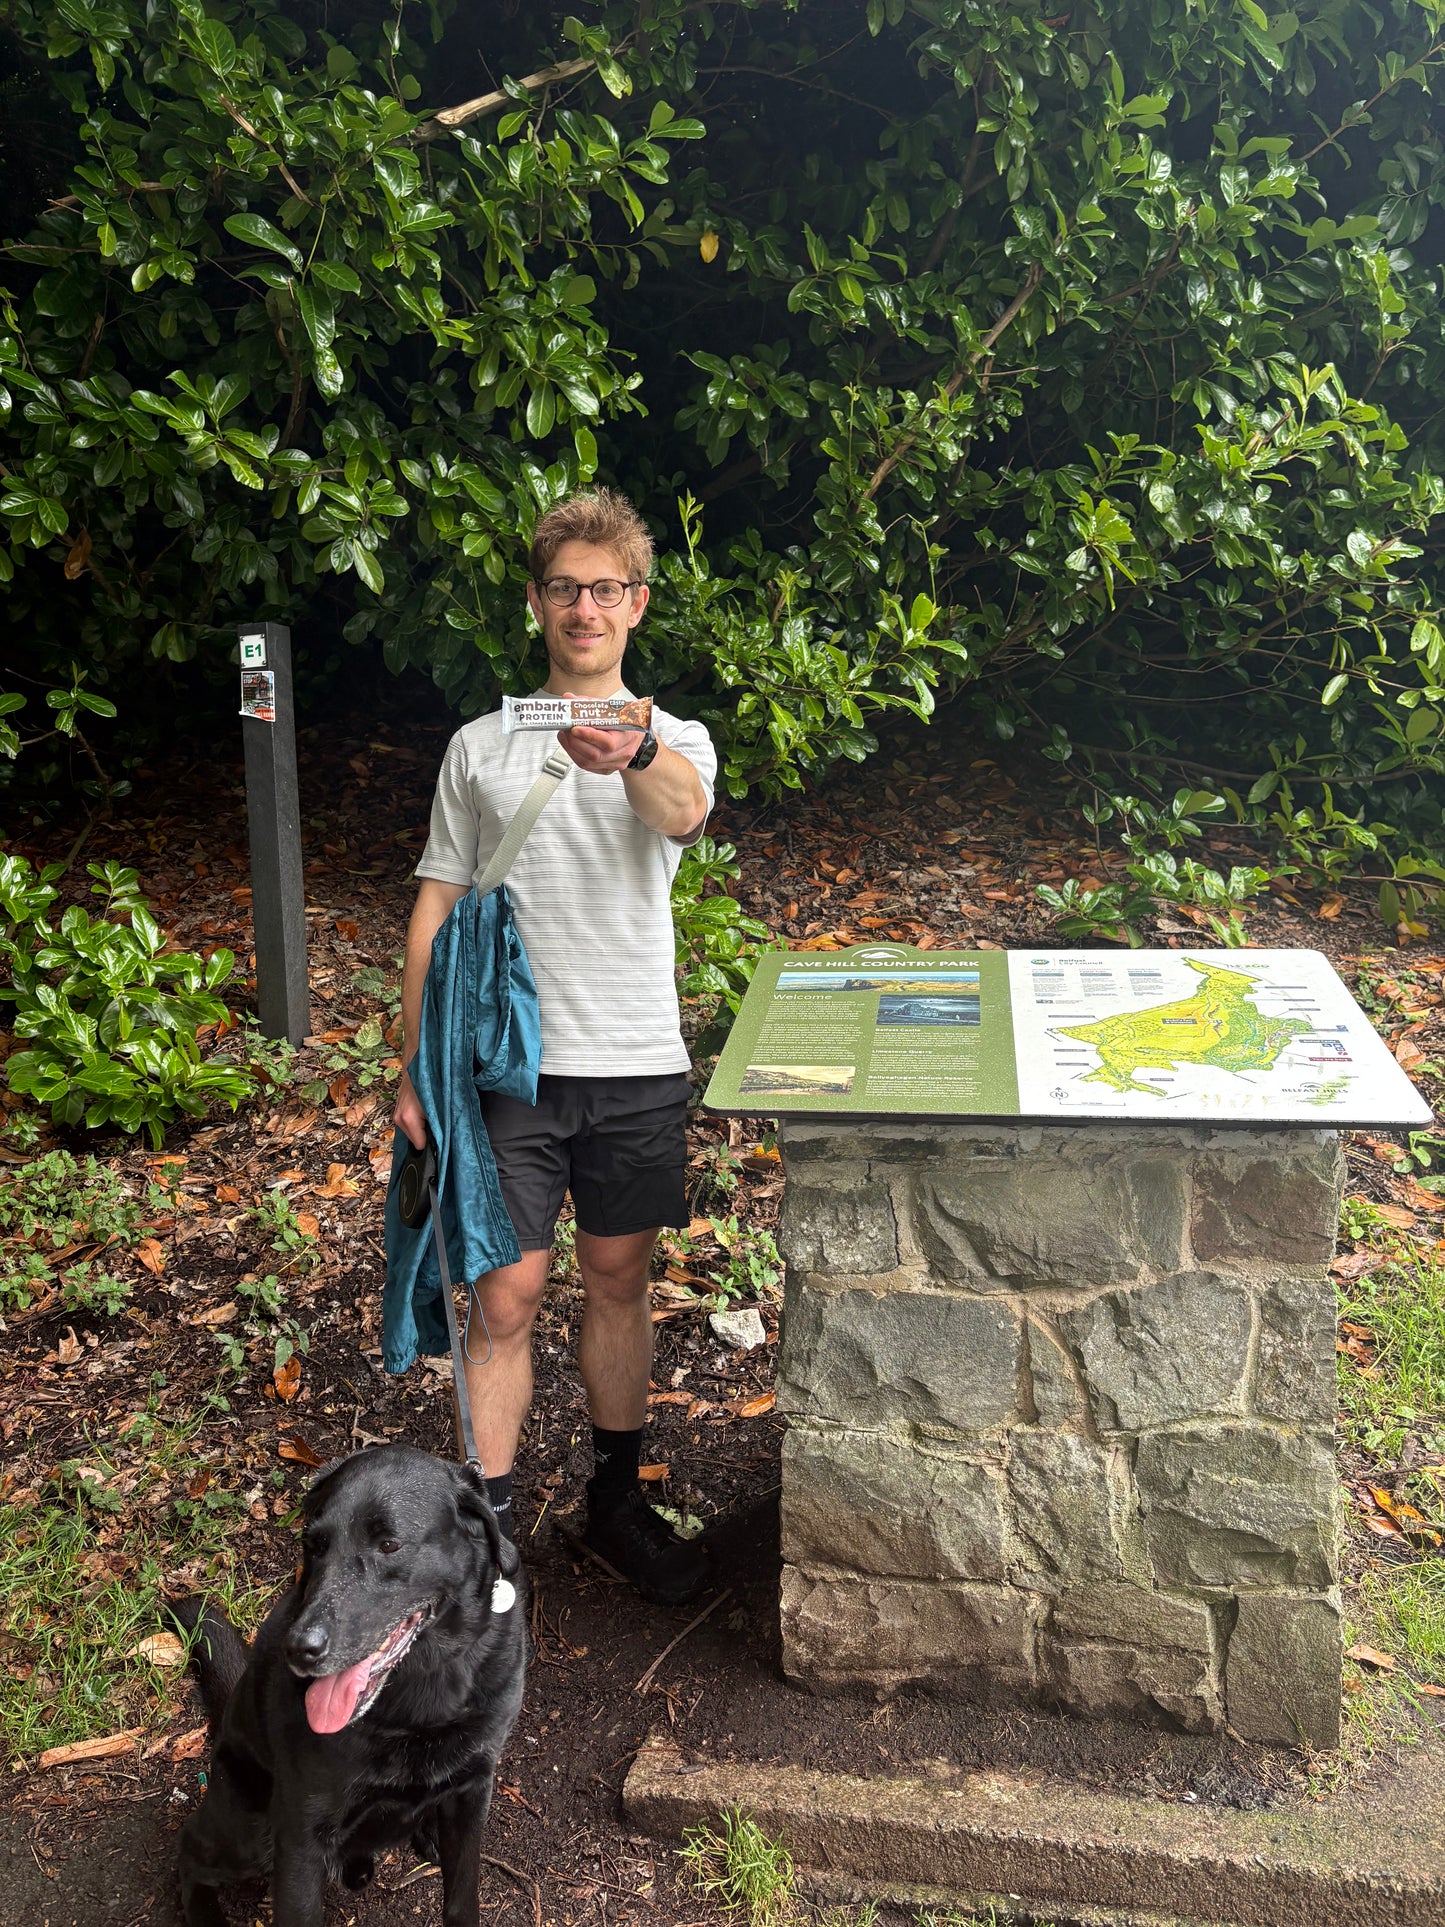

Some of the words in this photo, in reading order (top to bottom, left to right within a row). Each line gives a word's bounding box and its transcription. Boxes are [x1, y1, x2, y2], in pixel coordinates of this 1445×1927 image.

[244, 643, 262, 658] E1
[513, 701, 567, 712] embark
[519, 713, 563, 721] PROTEIN
[579, 708, 601, 718] nut
